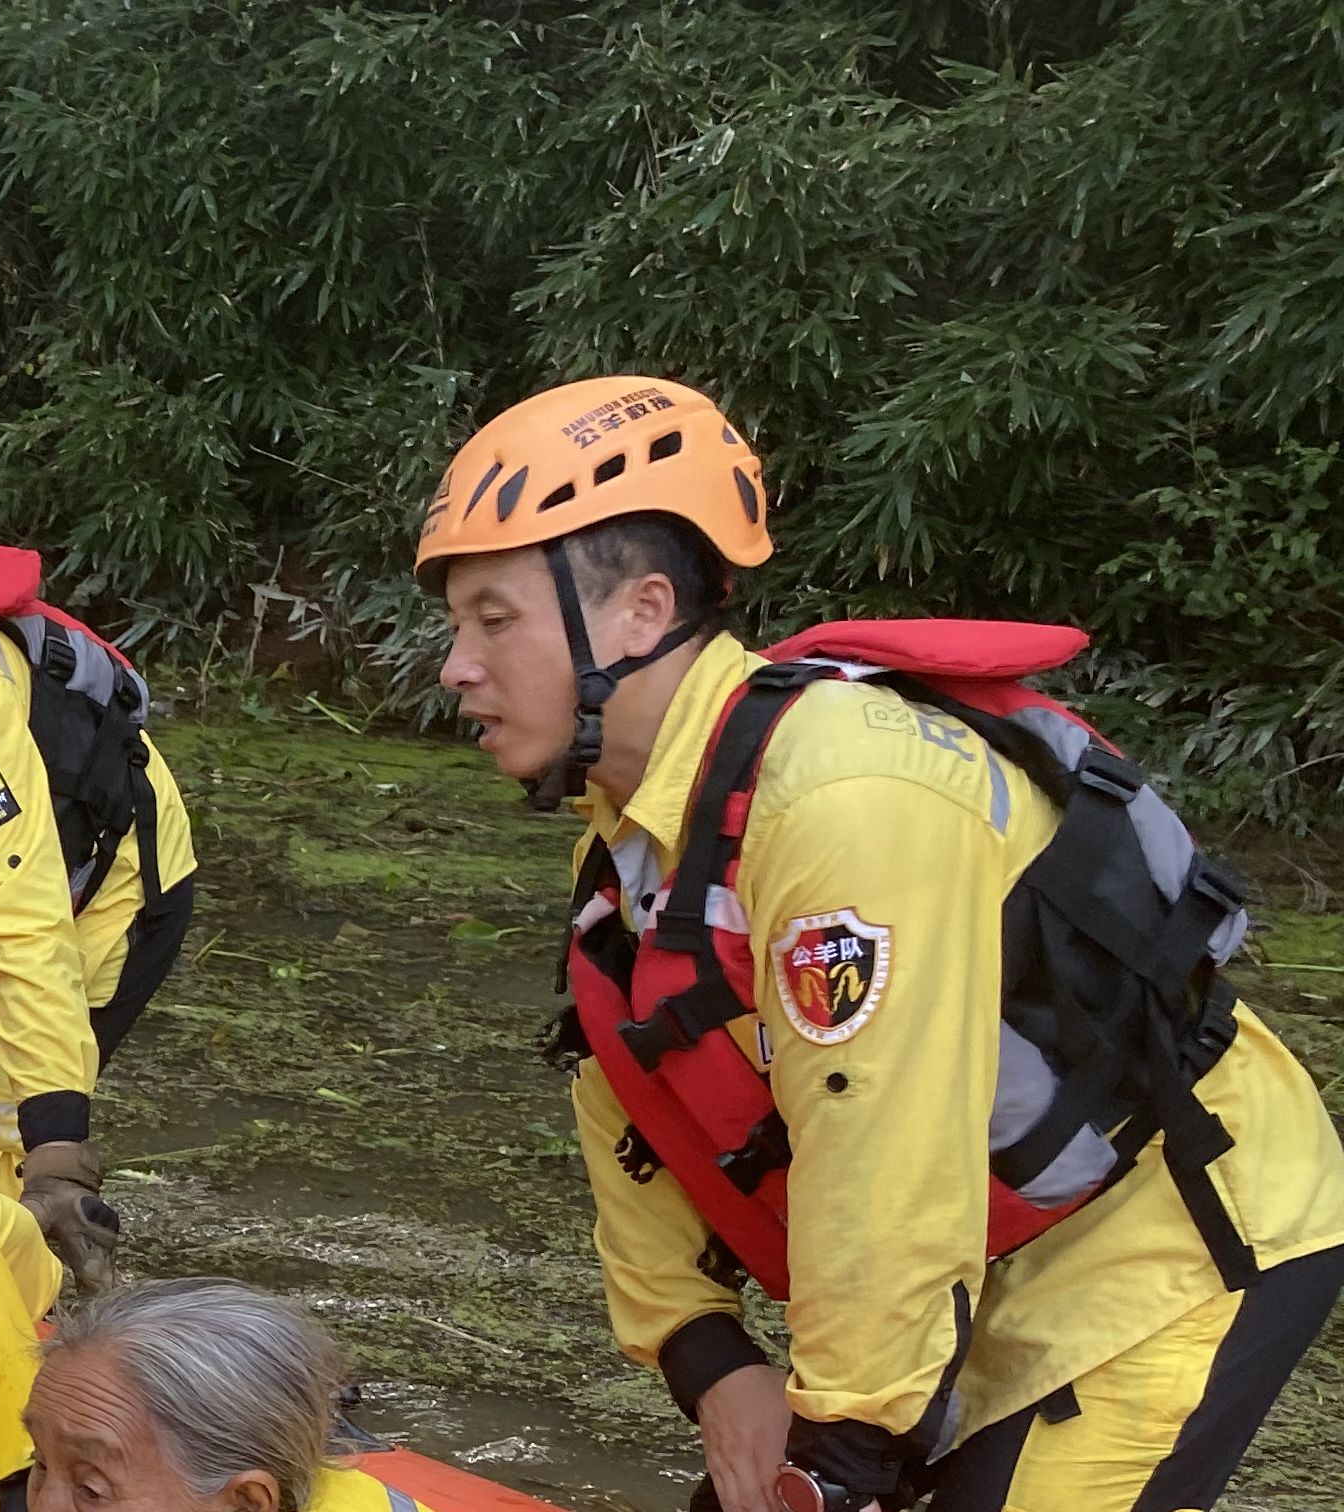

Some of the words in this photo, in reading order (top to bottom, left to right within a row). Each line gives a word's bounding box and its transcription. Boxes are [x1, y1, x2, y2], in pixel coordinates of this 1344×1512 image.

[573, 395, 676, 449] 公羊救援
[791, 936, 864, 968] 公羊队
